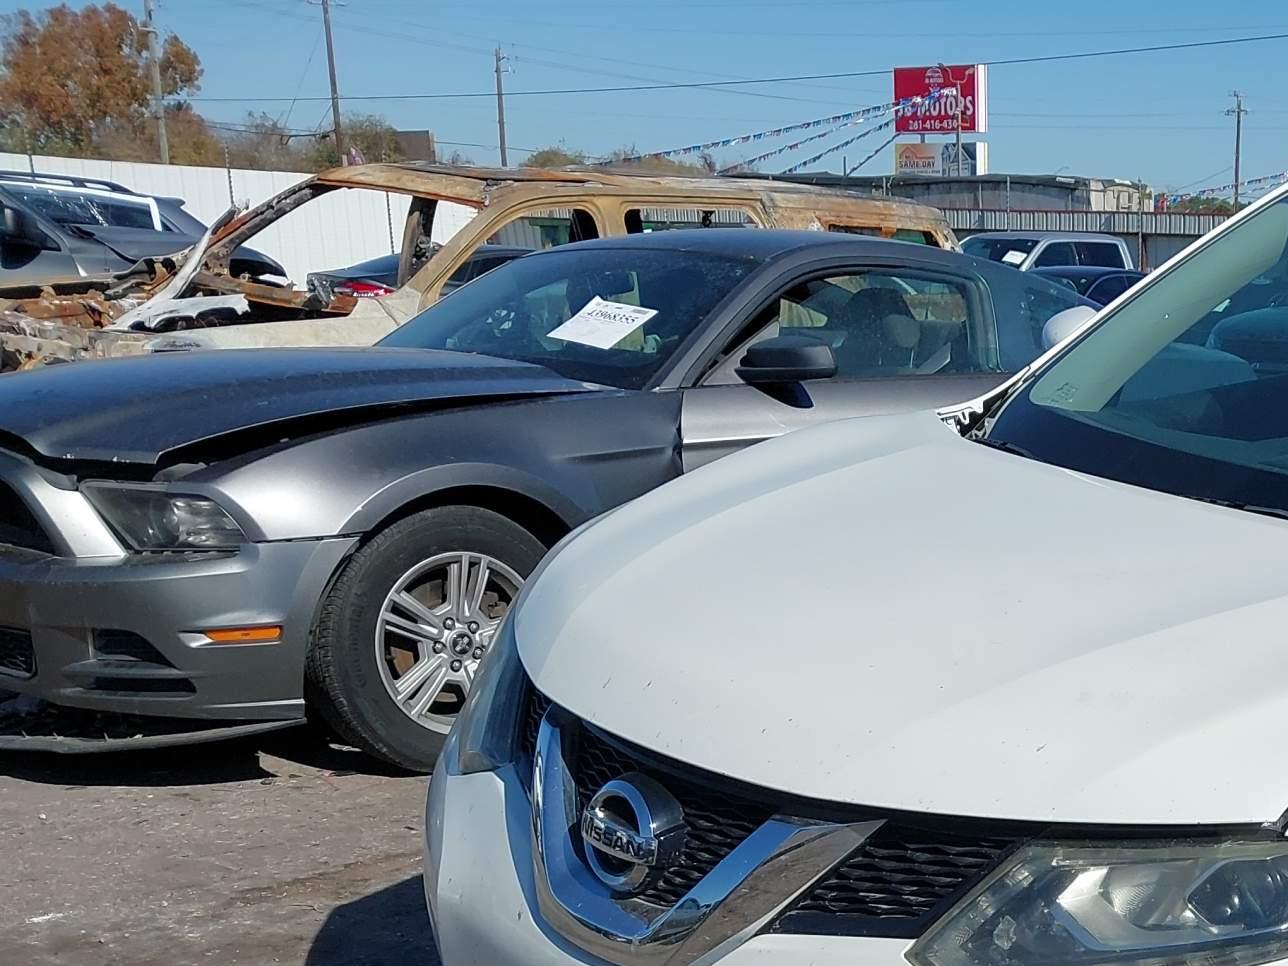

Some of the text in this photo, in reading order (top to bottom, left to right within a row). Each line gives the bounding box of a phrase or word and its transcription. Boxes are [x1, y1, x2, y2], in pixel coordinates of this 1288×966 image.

[899, 160, 936, 169] SAME DAY
[583, 814, 644, 857] NISSAN
